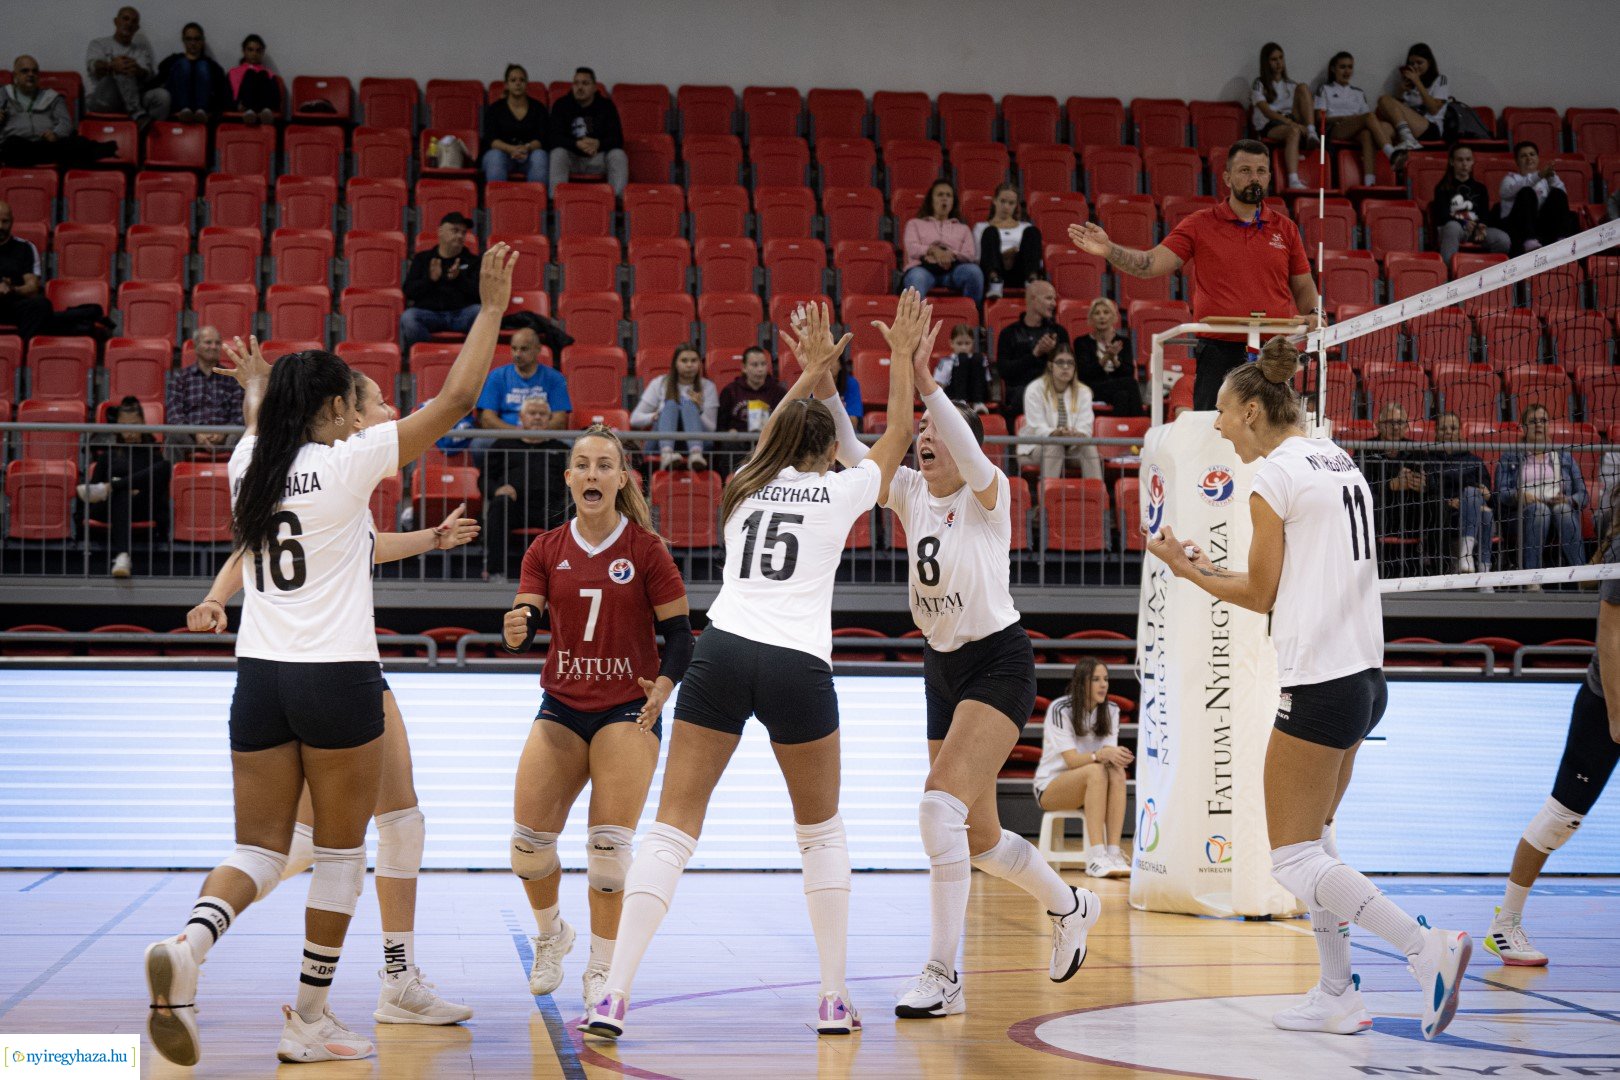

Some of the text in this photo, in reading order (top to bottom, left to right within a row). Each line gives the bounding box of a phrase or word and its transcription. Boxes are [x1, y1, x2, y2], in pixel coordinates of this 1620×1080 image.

[251, 511, 307, 592] 16
[739, 510, 804, 581] 15
[1343, 485, 1371, 561] 11
[916, 536, 941, 587] 8
[579, 588, 603, 642] 7
[556, 648, 634, 675] FATUM
[556, 673, 634, 681] PROPERTY
[1142, 570, 1160, 767] FATUM
